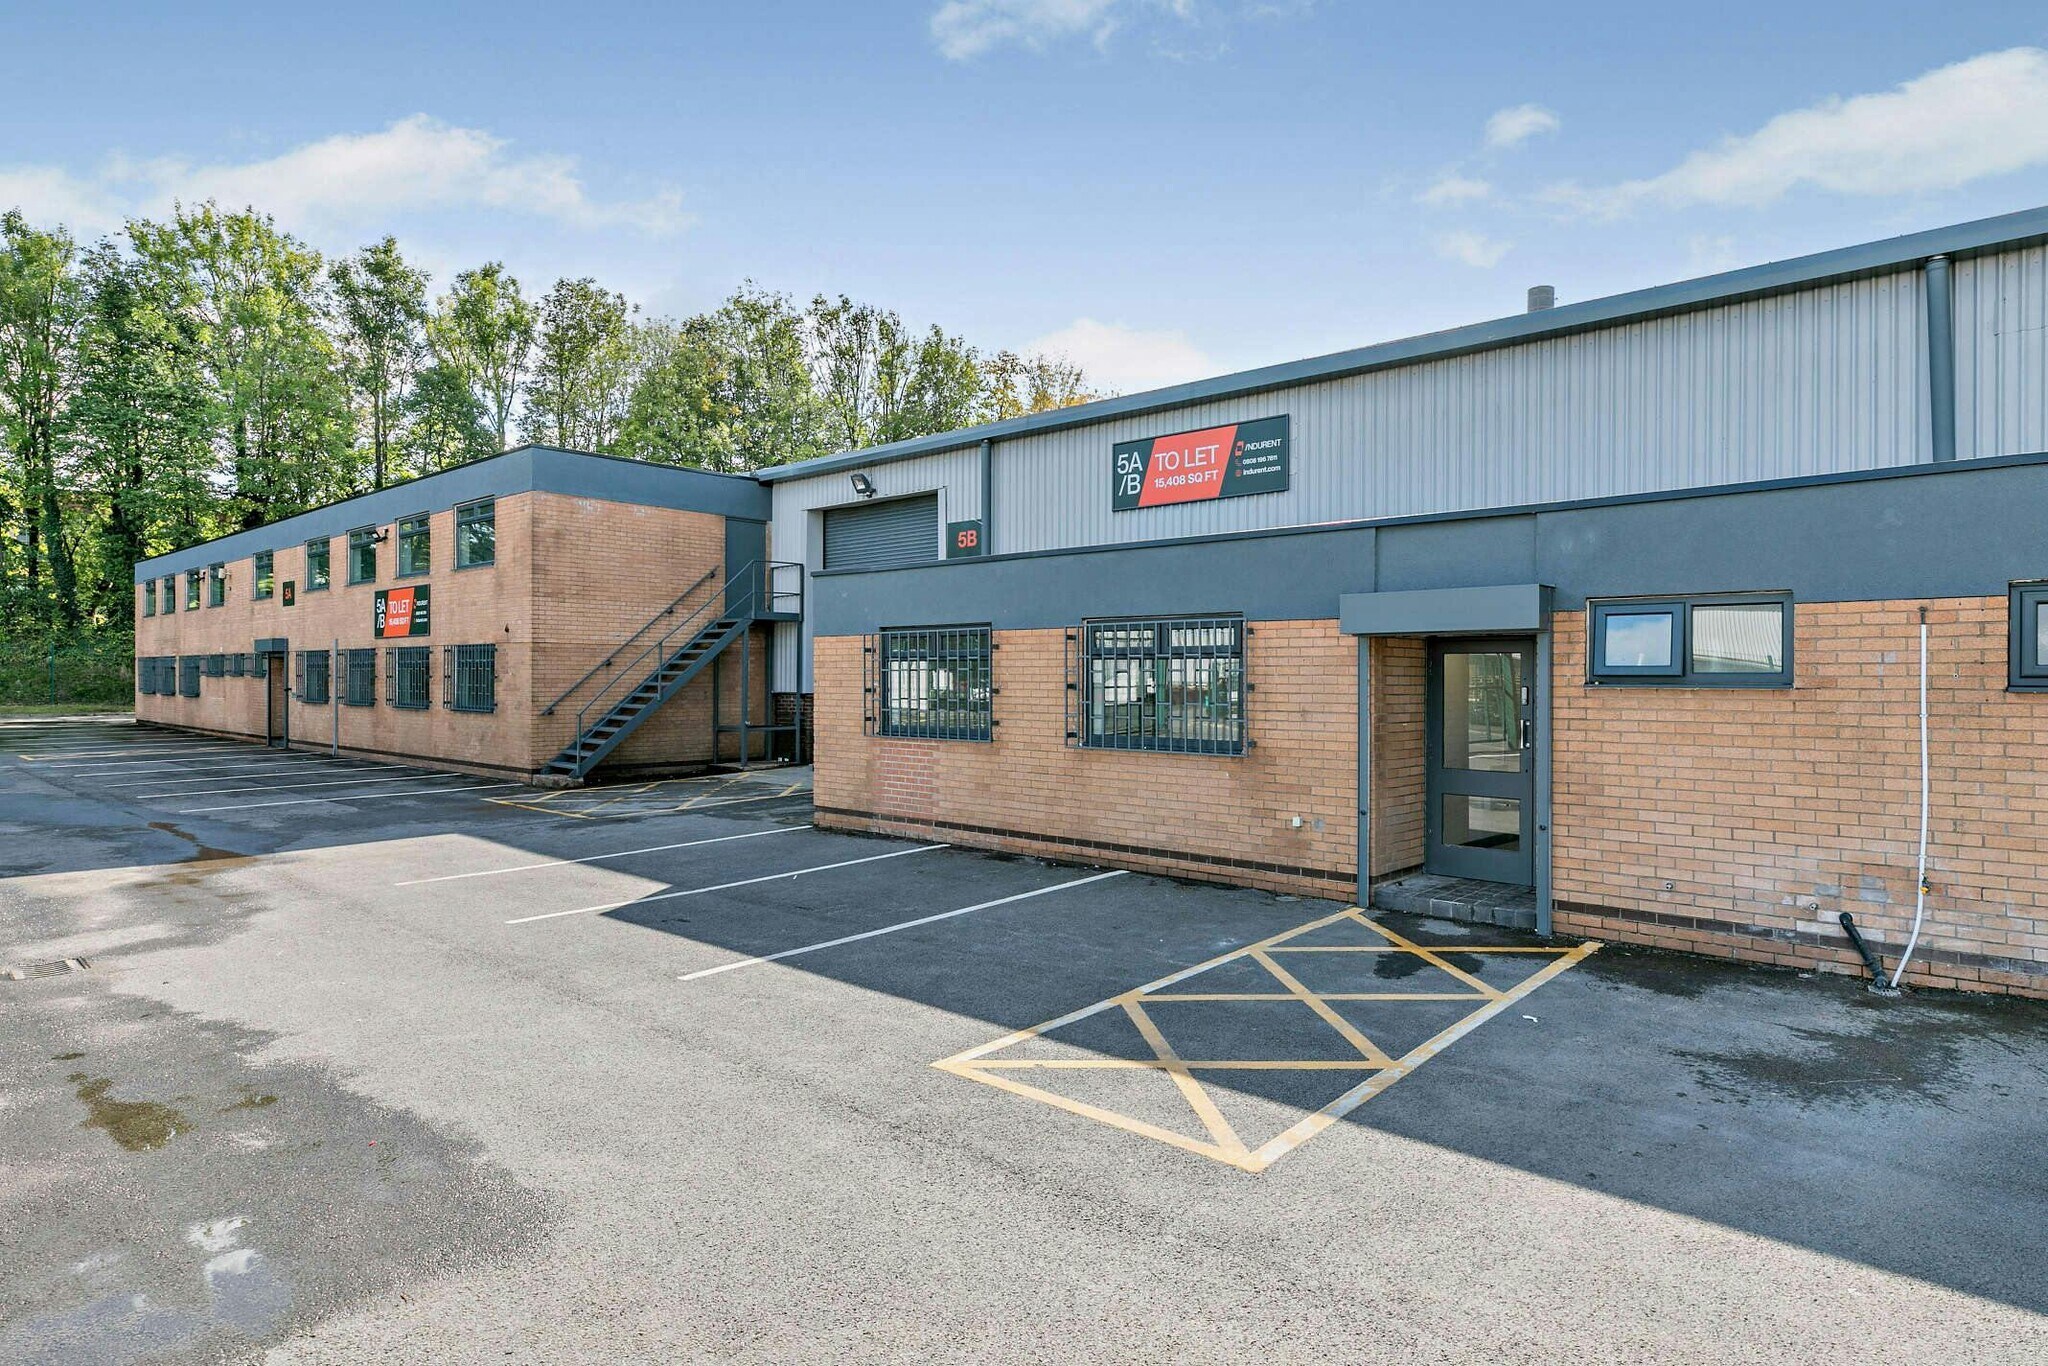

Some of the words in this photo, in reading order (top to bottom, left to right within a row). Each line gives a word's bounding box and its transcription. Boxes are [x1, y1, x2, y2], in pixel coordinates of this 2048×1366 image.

[1117, 451, 1143, 474] 5A
[1154, 451, 1180, 472] TO
[1184, 444, 1220, 467] LET
[1154, 475, 1186, 489] 15,408
[1187, 472, 1203, 484] SQ
[1205, 469, 1219, 481] FT
[957, 529, 977, 548] 5B
[376, 598, 386, 613] 5A
[389, 601, 398, 615] TO
[398, 599, 410, 614] LET
